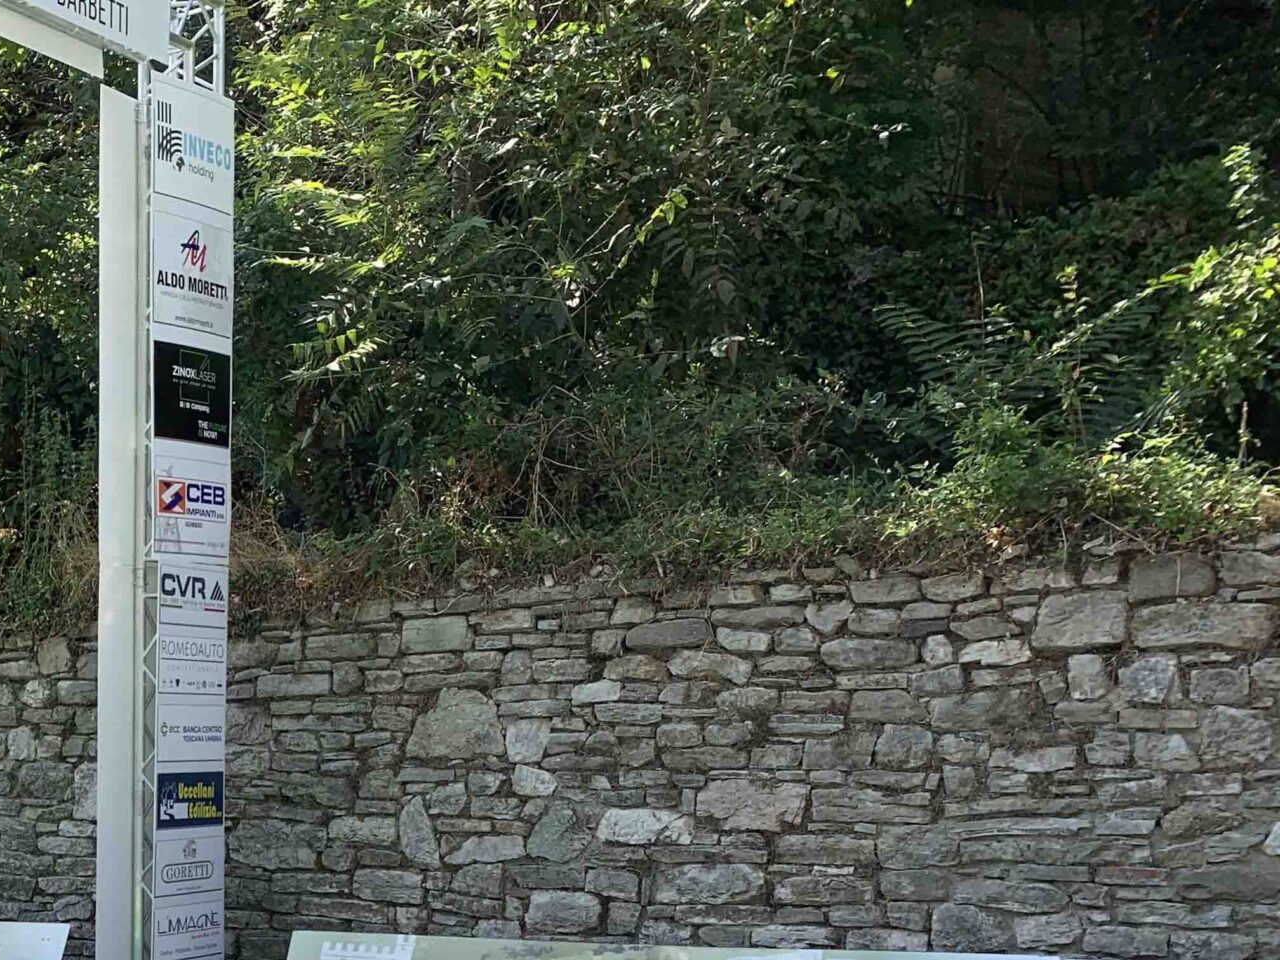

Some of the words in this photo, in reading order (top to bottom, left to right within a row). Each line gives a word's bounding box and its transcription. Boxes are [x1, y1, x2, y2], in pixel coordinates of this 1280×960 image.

[57, 0, 129, 36] RBETTI
[183, 132, 231, 170] INVECO
[157, 270, 185, 289] ALDO
[188, 276, 228, 300] MORETTI
[186, 483, 225, 506] CEB
[186, 508, 216, 518] IMPIANTI
[161, 573, 206, 599] CVR
[161, 640, 224, 658] ROMEOAUTO
[166, 864, 209, 880] GORETTI
